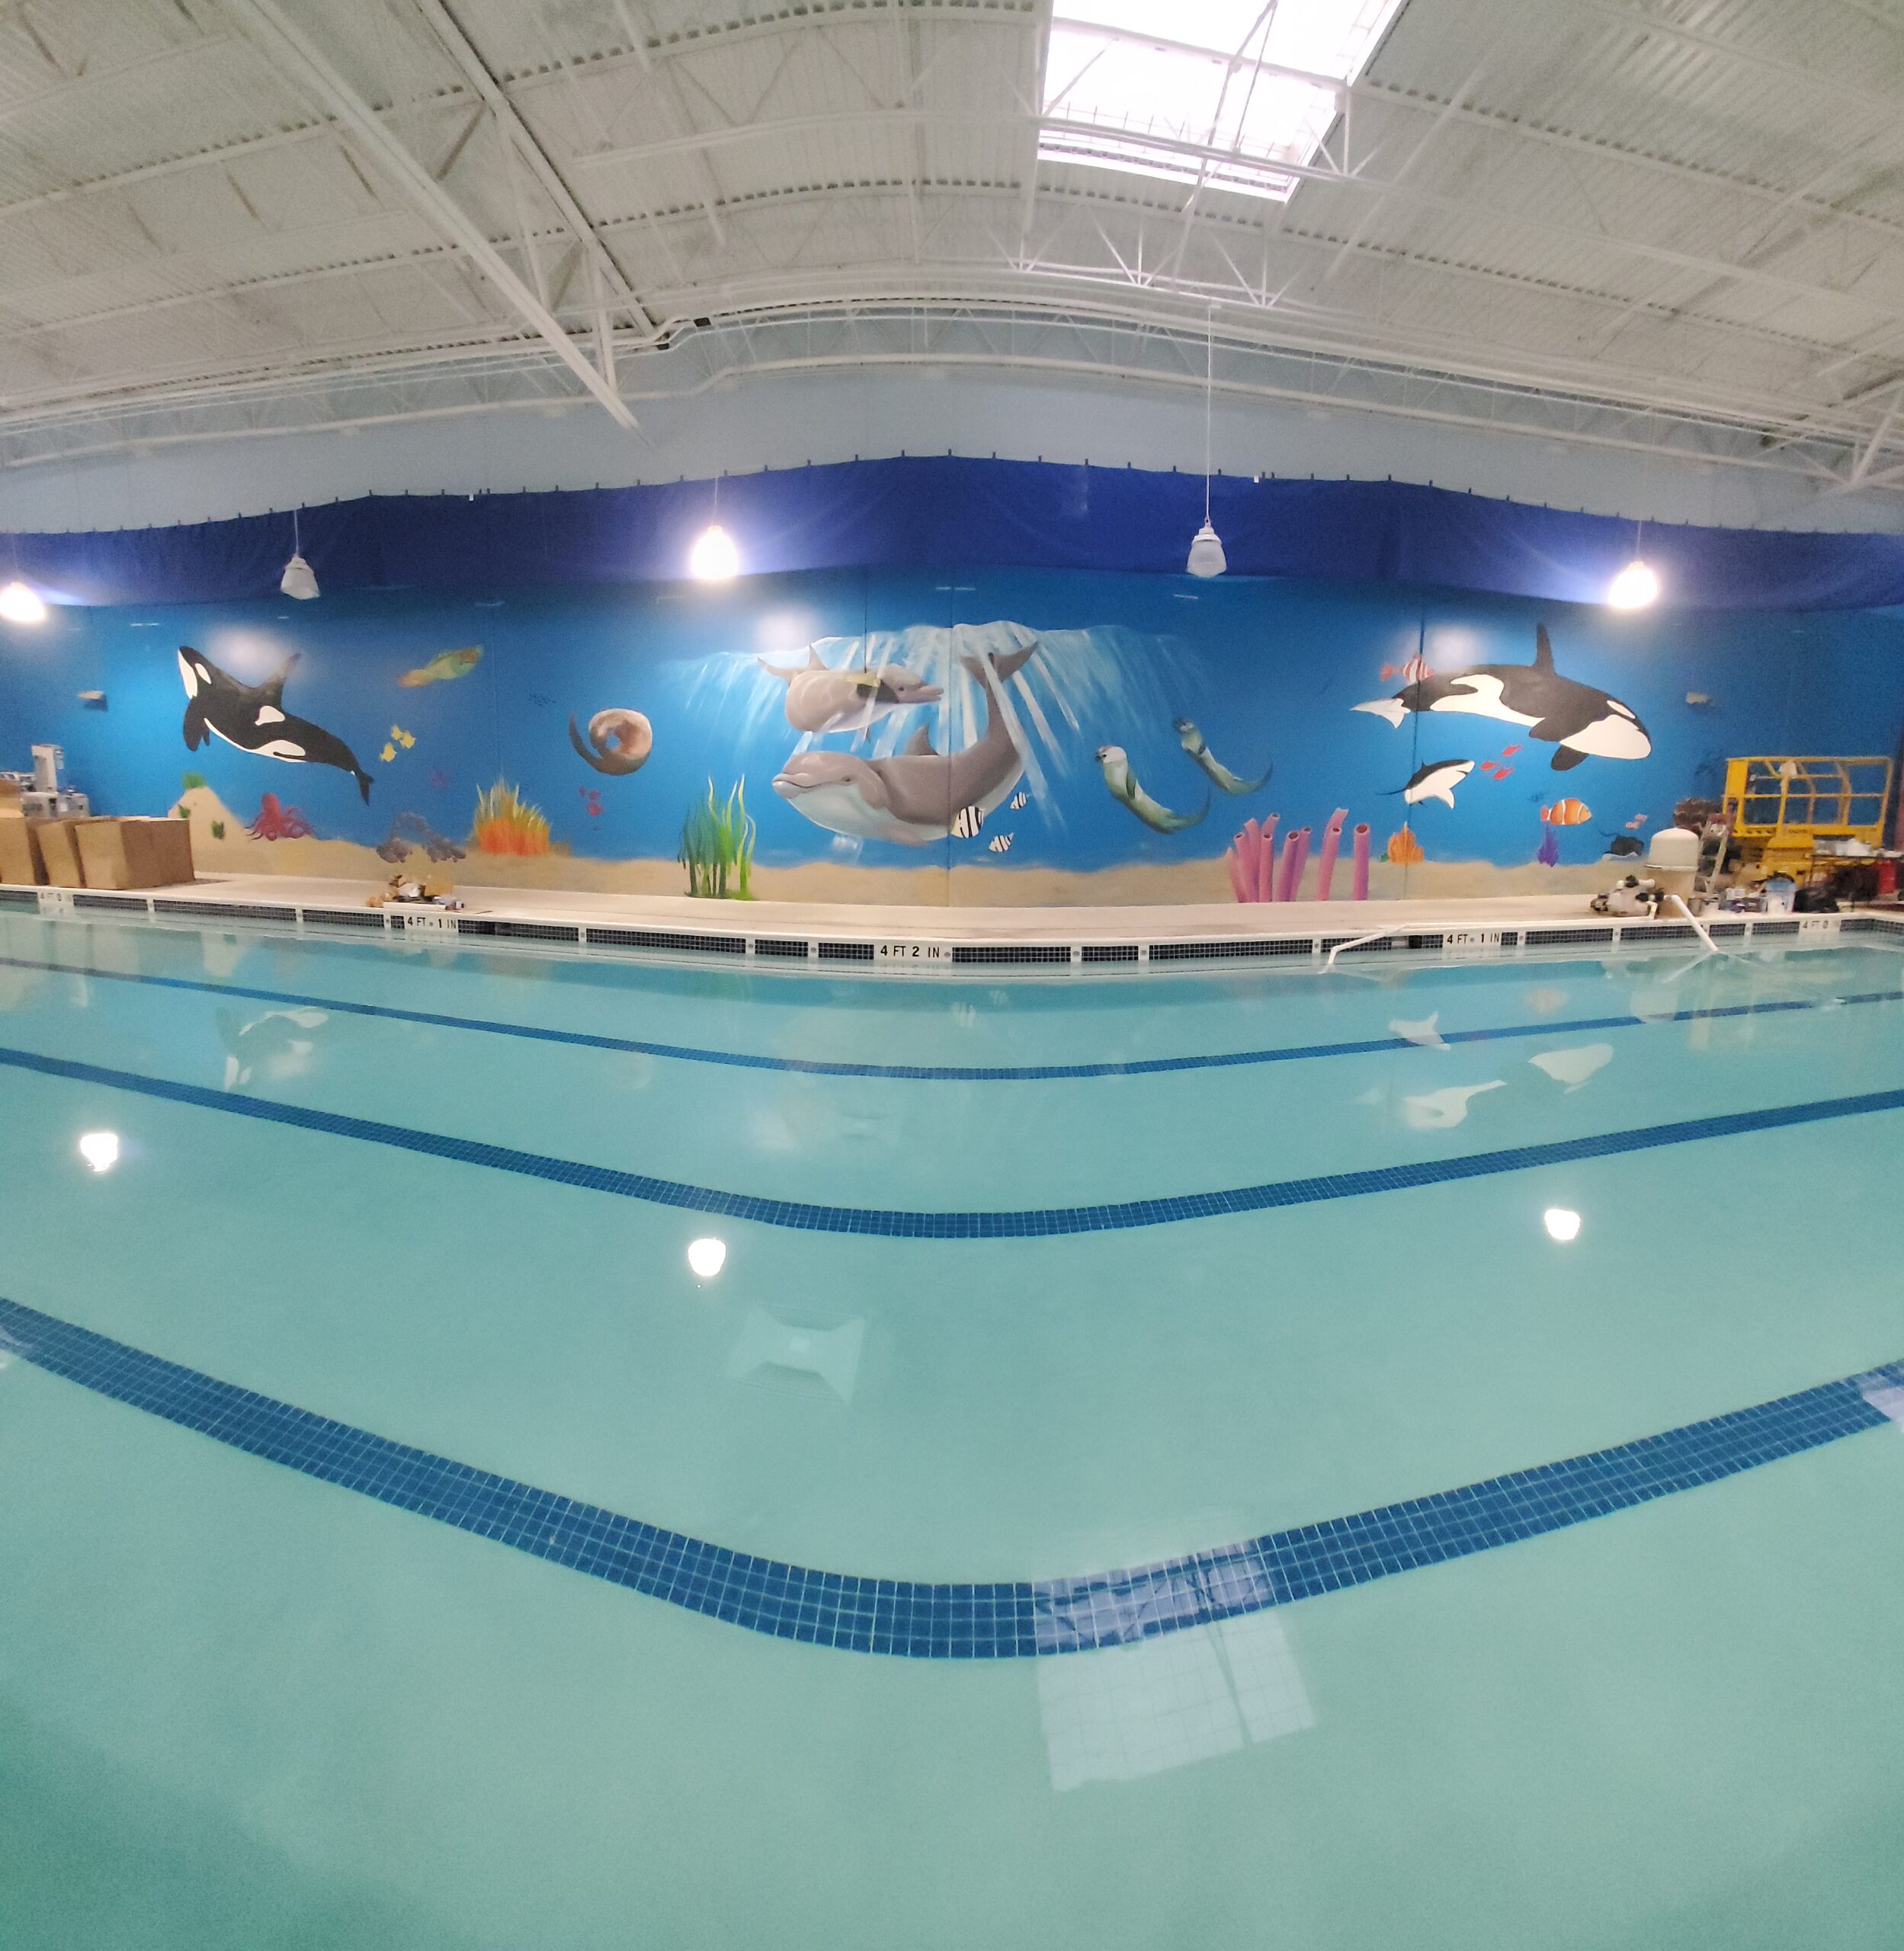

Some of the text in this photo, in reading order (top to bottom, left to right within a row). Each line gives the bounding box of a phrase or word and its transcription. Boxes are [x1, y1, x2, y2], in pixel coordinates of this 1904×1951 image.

[407, 916, 457, 929] 4 FT 1 IN
[1447, 932, 1500, 944] 4 FT 1 IN
[880, 945, 940, 958] 4 FT 2 IN
